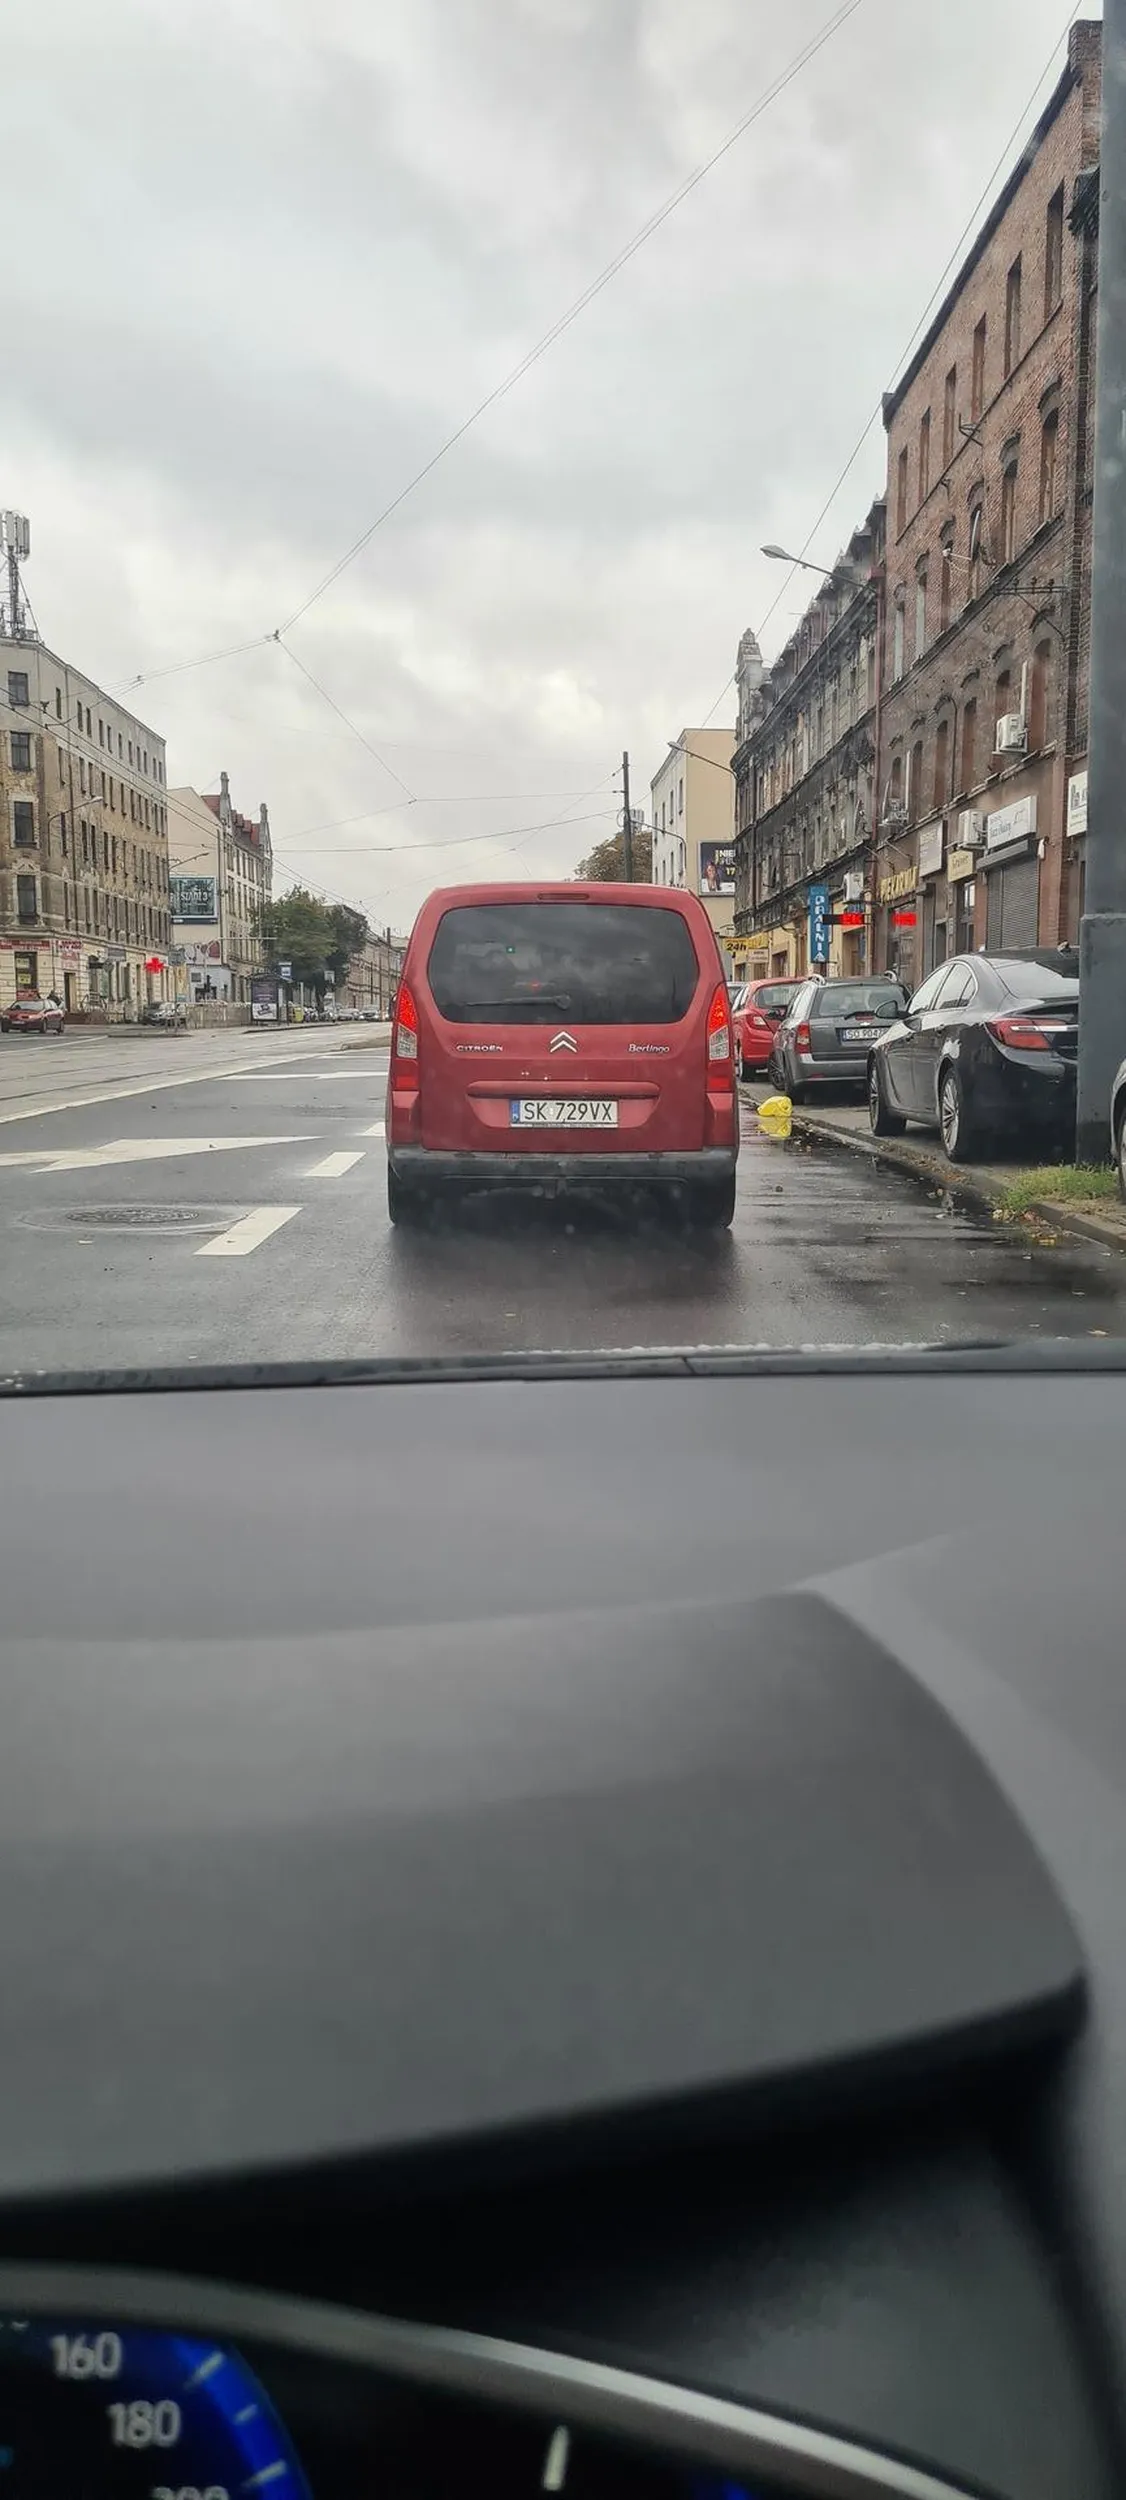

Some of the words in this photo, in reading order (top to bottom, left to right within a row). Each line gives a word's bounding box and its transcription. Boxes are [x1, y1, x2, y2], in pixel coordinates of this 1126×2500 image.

[814, 895, 826, 962] PRALNIA
[726, 943, 747, 951] 24h
[628, 1043, 670, 1053] Berlingo
[524, 1102, 547, 1121] SK
[555, 1102, 612, 1121] 729VX
[51, 2331, 122, 2380] 160
[107, 2399, 181, 2448] 180
